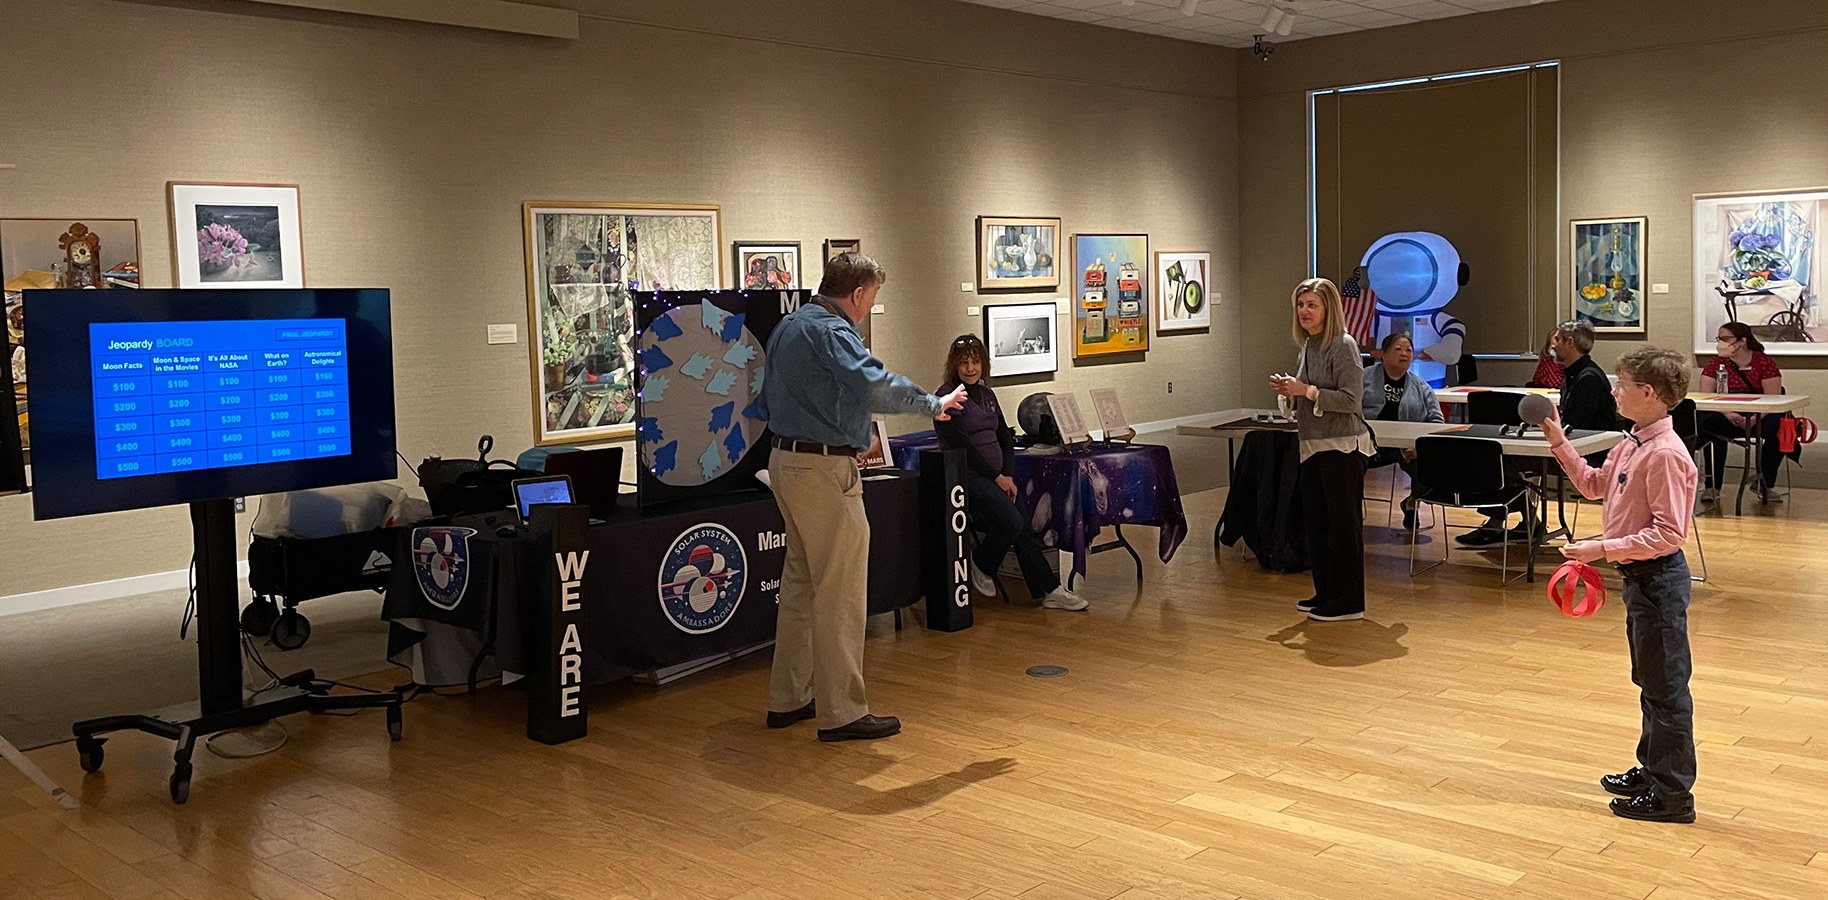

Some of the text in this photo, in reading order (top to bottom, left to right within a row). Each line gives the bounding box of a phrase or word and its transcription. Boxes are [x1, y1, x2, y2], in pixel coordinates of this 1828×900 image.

[108, 338, 193, 350] Jeopardy BOARD
[268, 375, 287, 383] $100
[315, 372, 333, 380] $100
[168, 380, 188, 388] $100
[220, 377, 239, 386] $100
[113, 382, 135, 391] $100
[221, 396, 240, 405] $200
[270, 393, 288, 401] $200
[114, 403, 136, 412] $200
[169, 399, 189, 408] $200
[270, 412, 289, 420] $300
[317, 408, 334, 416] $300
[170, 419, 190, 428] $300
[222, 415, 241, 424] $300
[115, 423, 137, 432] $300
[318, 426, 335, 434] $400
[222, 434, 242, 442] $400
[271, 430, 290, 438] $400
[116, 442, 138, 452] $400
[171, 438, 191, 447] $400
[272, 448, 290, 457] $500
[318, 444, 336, 452] $500
[172, 457, 192, 466] $500
[223, 453, 242, 462] $500
[117, 462, 139, 472] $500
[674, 530, 731, 555] SOLAR SYSTEM
[758, 531, 786, 551] Mar
[950, 485, 969, 607] GOING
[761, 579, 779, 591] Solar
[677, 602, 733, 627] AMBASSADORS
[555, 550, 590, 717] WE ARE
